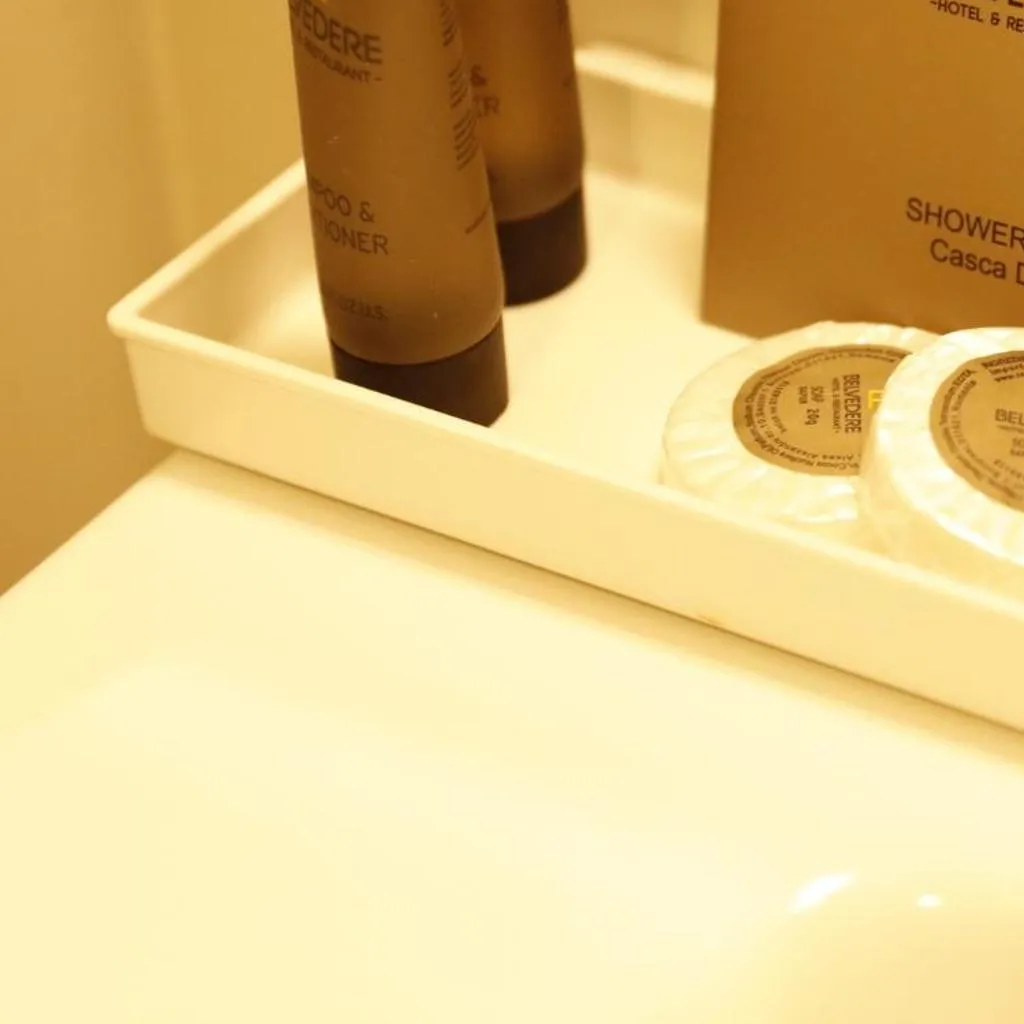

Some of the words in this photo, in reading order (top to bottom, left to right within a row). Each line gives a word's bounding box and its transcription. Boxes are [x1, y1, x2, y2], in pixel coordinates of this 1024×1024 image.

[990, 12, 1000, 26] &
[360, 200, 375, 223] &
[929, 238, 1007, 280] Casca
[842, 374, 862, 433] BELVEDERE
